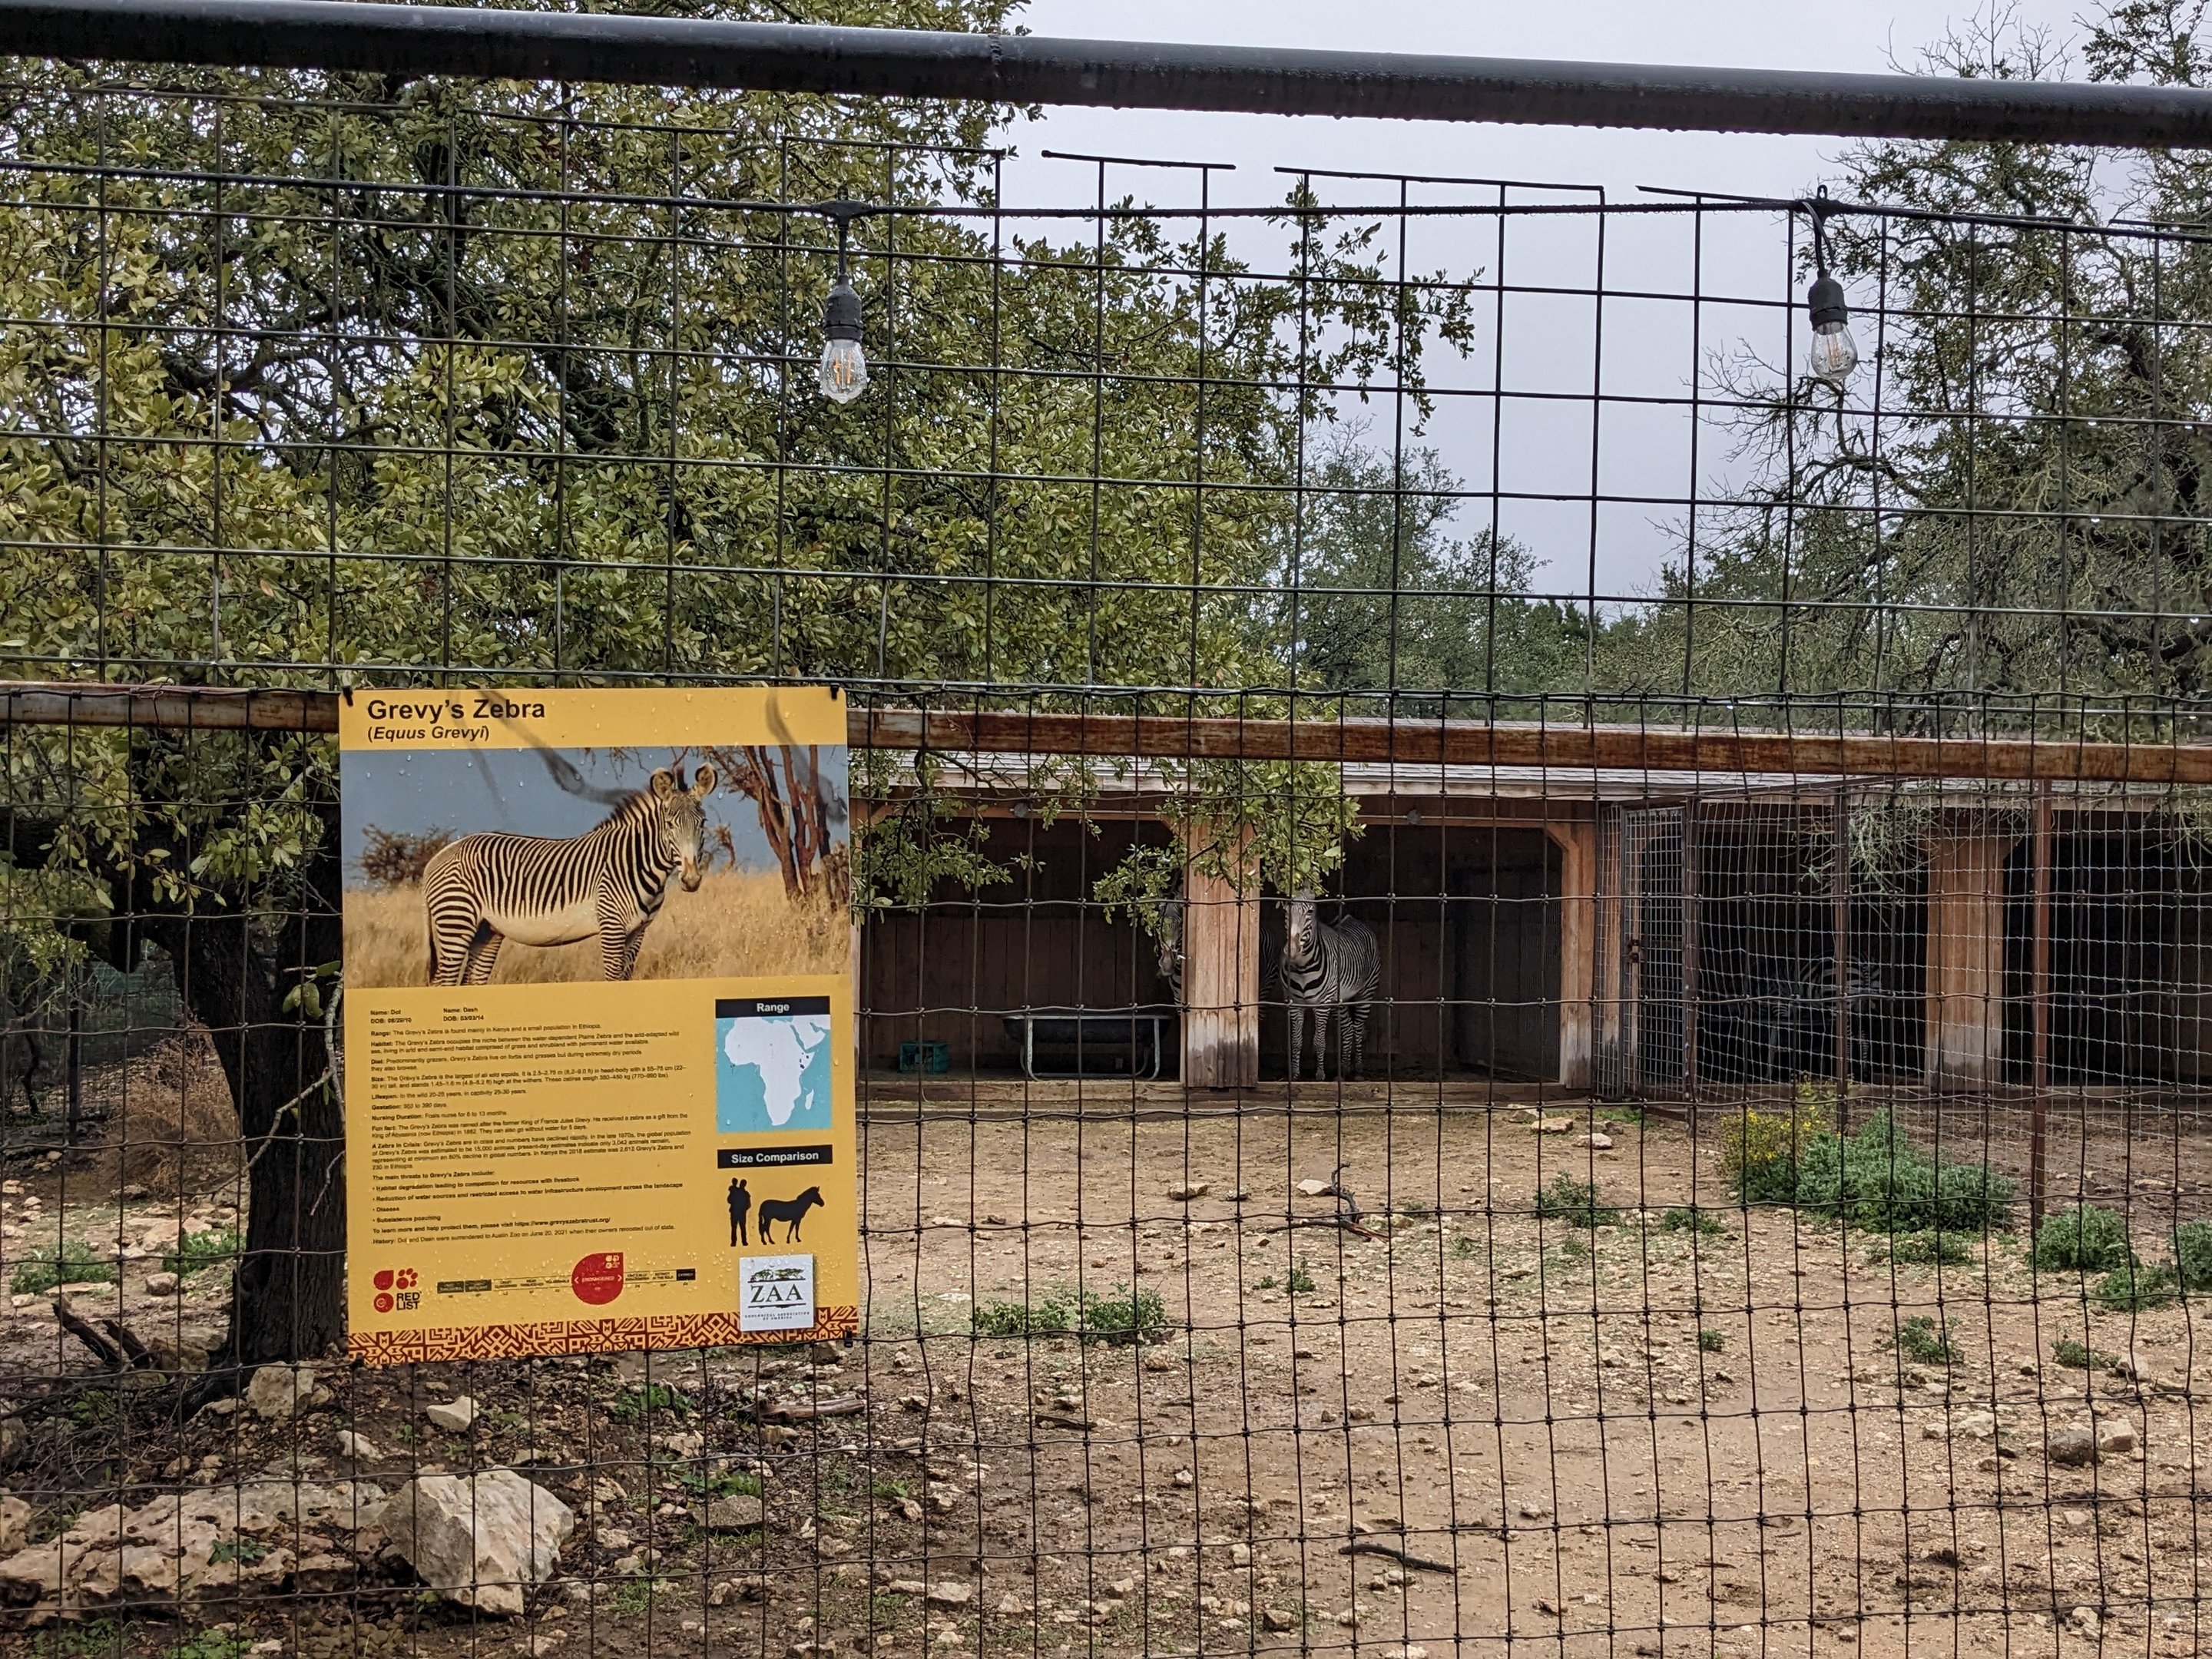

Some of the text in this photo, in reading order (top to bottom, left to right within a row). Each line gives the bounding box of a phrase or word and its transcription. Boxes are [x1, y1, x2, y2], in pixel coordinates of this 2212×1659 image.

[367, 699, 545, 724] Grevy's Zebra
[368, 725, 489, 743] (Equus Grevyi)
[757, 1003, 790, 1013] Range
[731, 1151, 819, 1164] Size Comparison
[396, 1292, 420, 1301] RED
[750, 1283, 803, 1303] ZAA
[396, 1301, 420, 1310] LIST
